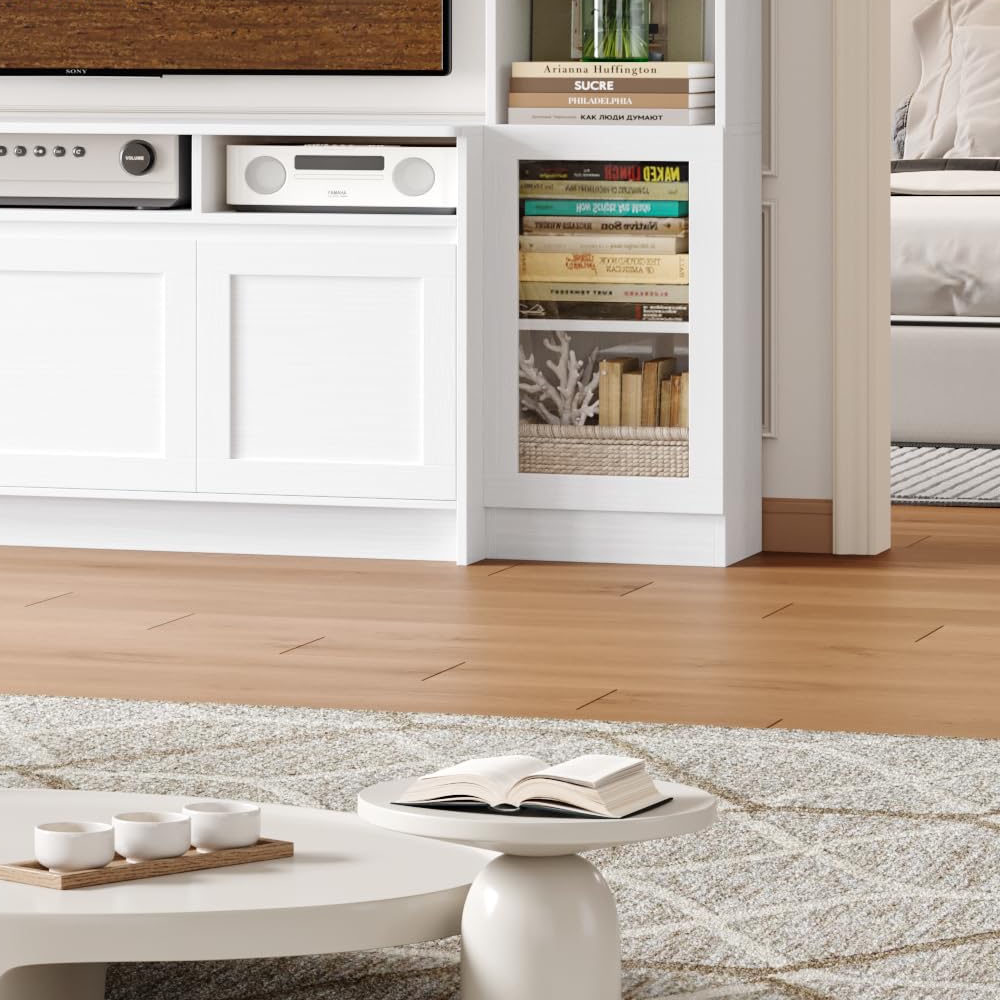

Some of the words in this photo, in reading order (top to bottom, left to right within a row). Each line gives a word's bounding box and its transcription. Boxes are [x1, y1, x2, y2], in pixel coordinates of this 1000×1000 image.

[543, 64, 589, 74] Arianna
[593, 64, 657, 76] Huffington
[574, 80, 614, 91] SUCRE
[568, 96, 633, 105] PHILADELPHIA
[626, 114, 663, 122] ДУМАЮТ
